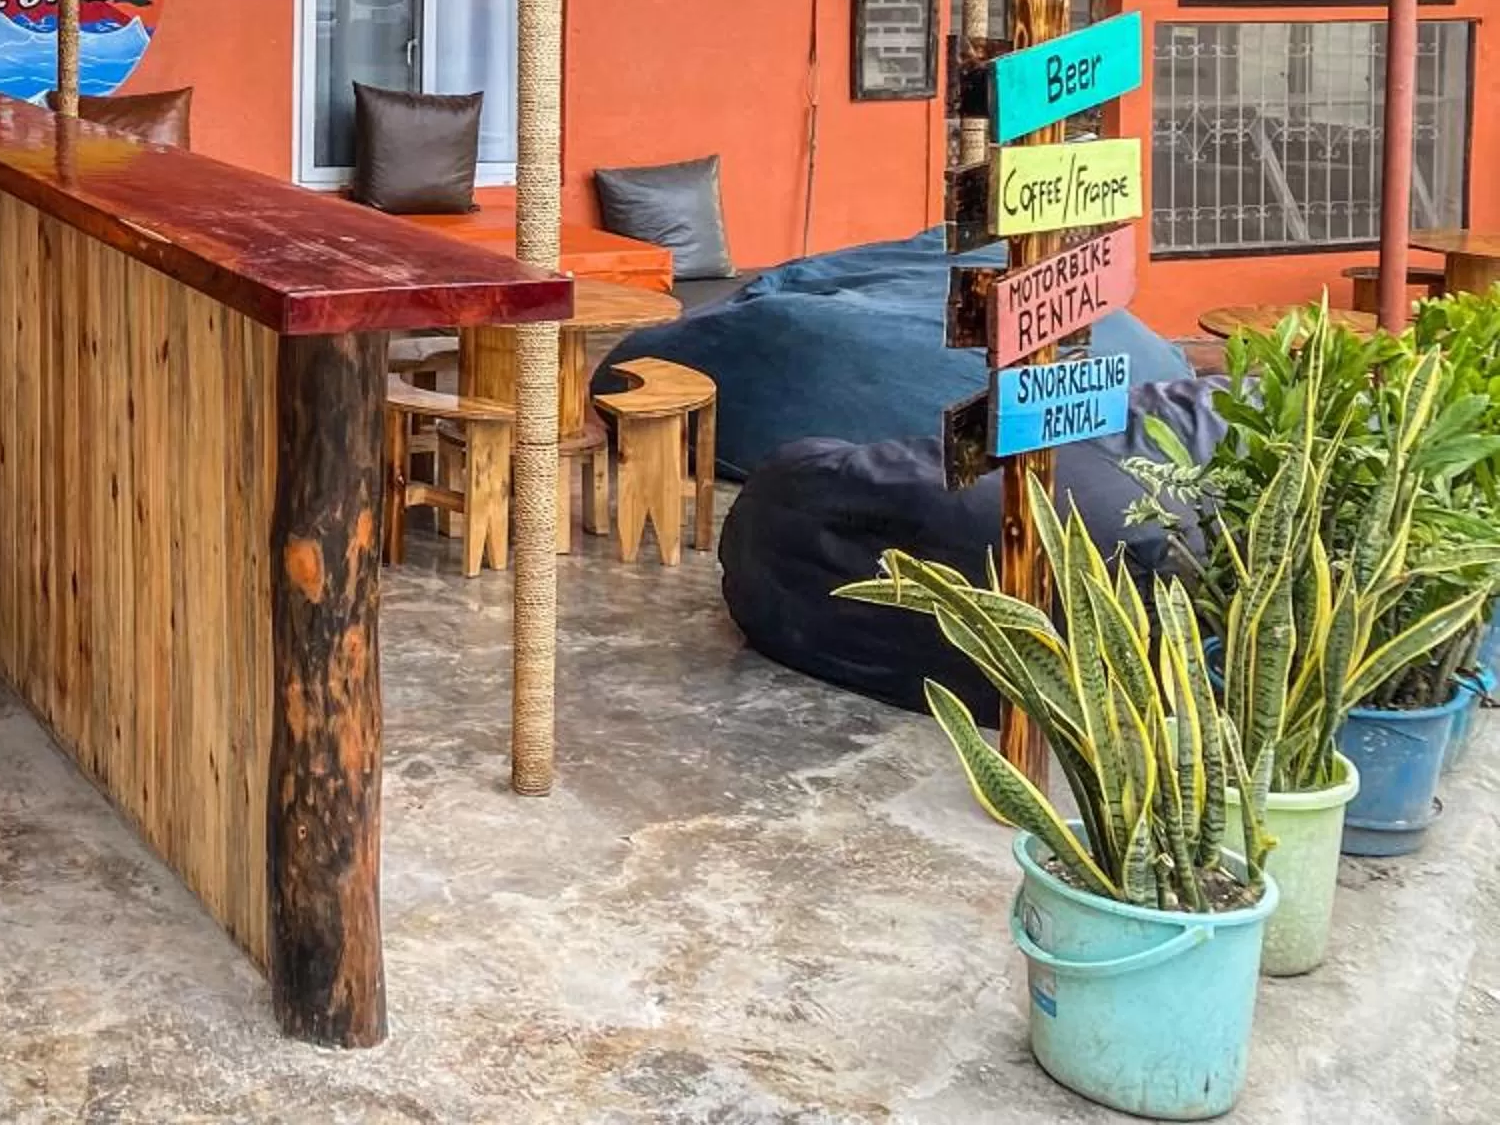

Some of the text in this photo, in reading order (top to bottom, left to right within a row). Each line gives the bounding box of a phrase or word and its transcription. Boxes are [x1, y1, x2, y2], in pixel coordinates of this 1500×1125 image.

[1046, 54, 1102, 104] Beer
[1009, 236, 1111, 312] MOTORBIKE
[1018, 277, 1108, 352] RENTAL
[1017, 357, 1125, 405] SNORKELING
[1042, 398, 1107, 441] RENTAL
